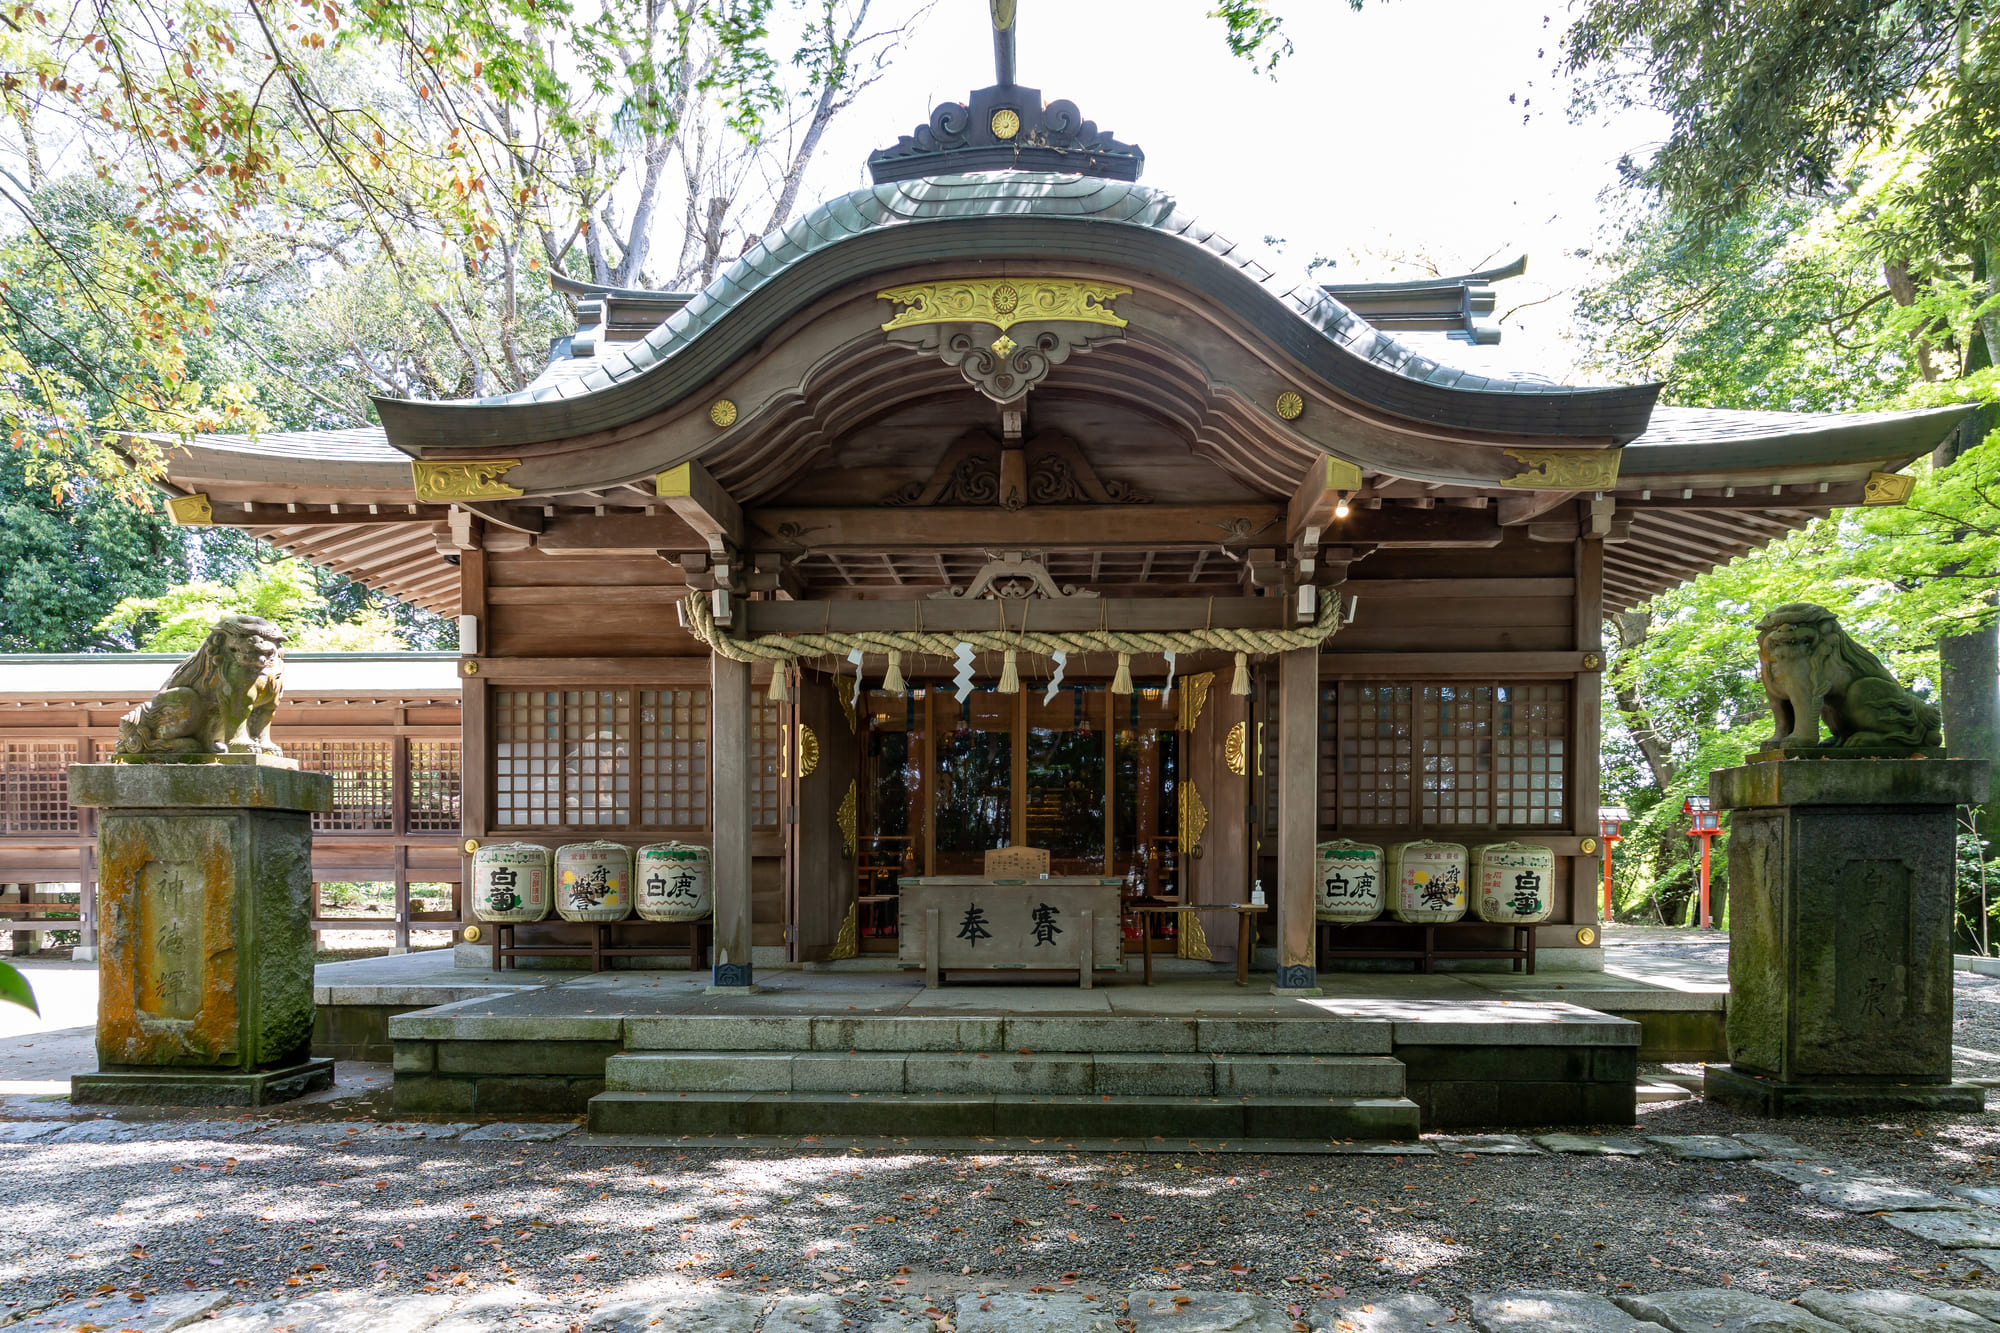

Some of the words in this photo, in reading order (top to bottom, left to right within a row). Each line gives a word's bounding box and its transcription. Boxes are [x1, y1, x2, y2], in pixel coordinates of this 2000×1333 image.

[490, 866, 517, 911] 白菊
[647, 872, 698, 898] 白鹿
[1326, 872, 1377, 898] 白鹿
[1514, 870, 1540, 915] 白菊
[957, 902, 1063, 948] 奉賽
